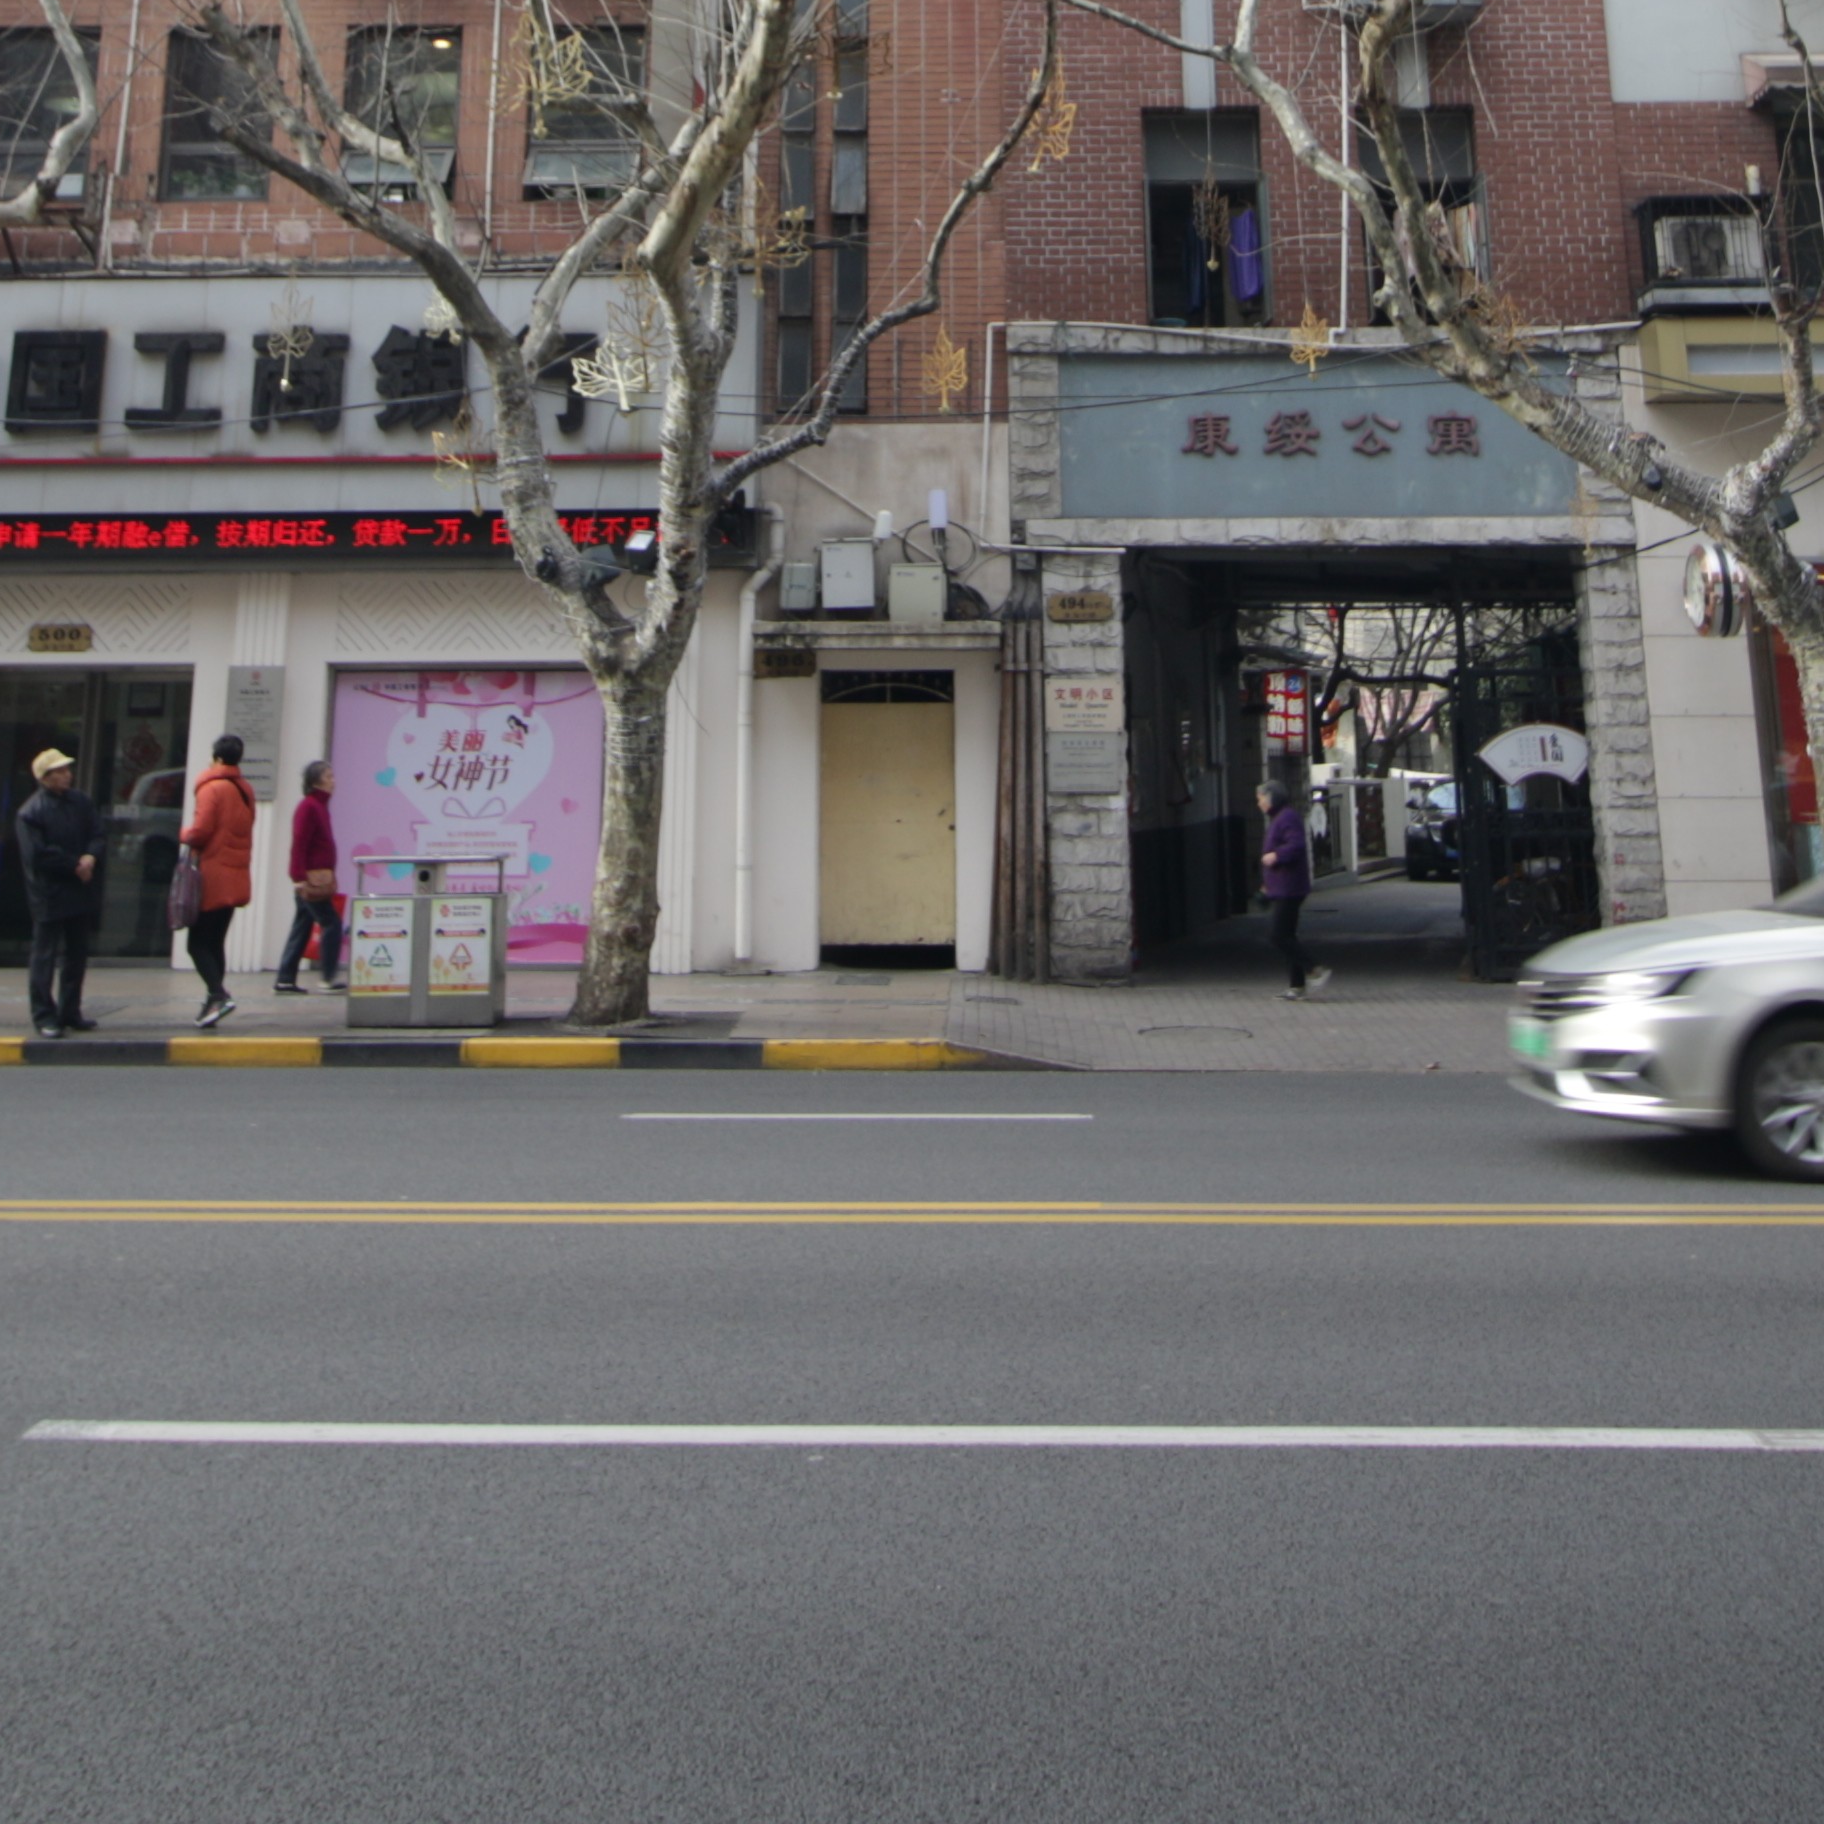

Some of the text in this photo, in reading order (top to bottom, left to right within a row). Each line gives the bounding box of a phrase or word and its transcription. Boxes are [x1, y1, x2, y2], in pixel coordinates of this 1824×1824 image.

[1181, 410, 1480, 457] 康绥公寓
[38, 627, 82, 642] 500
[1054, 687, 1114, 701] 文明小区
[437, 729, 487, 753] 美丽
[424, 754, 514, 792] 女神节
